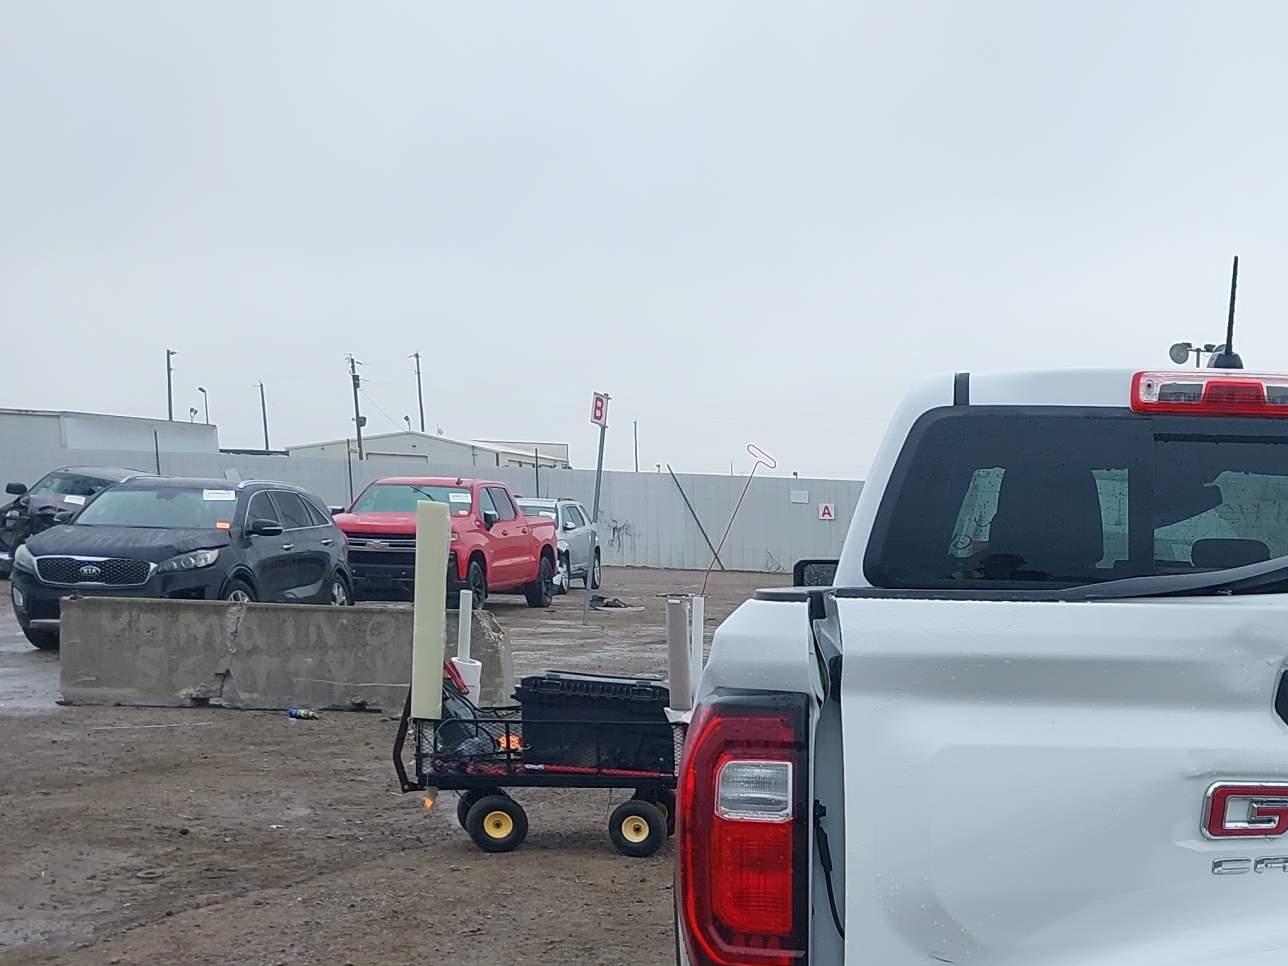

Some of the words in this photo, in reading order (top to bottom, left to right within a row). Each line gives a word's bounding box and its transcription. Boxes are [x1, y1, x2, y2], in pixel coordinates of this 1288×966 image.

[593, 396, 604, 421] B
[821, 504, 833, 518] A
[82, 566, 100, 576] KIA
